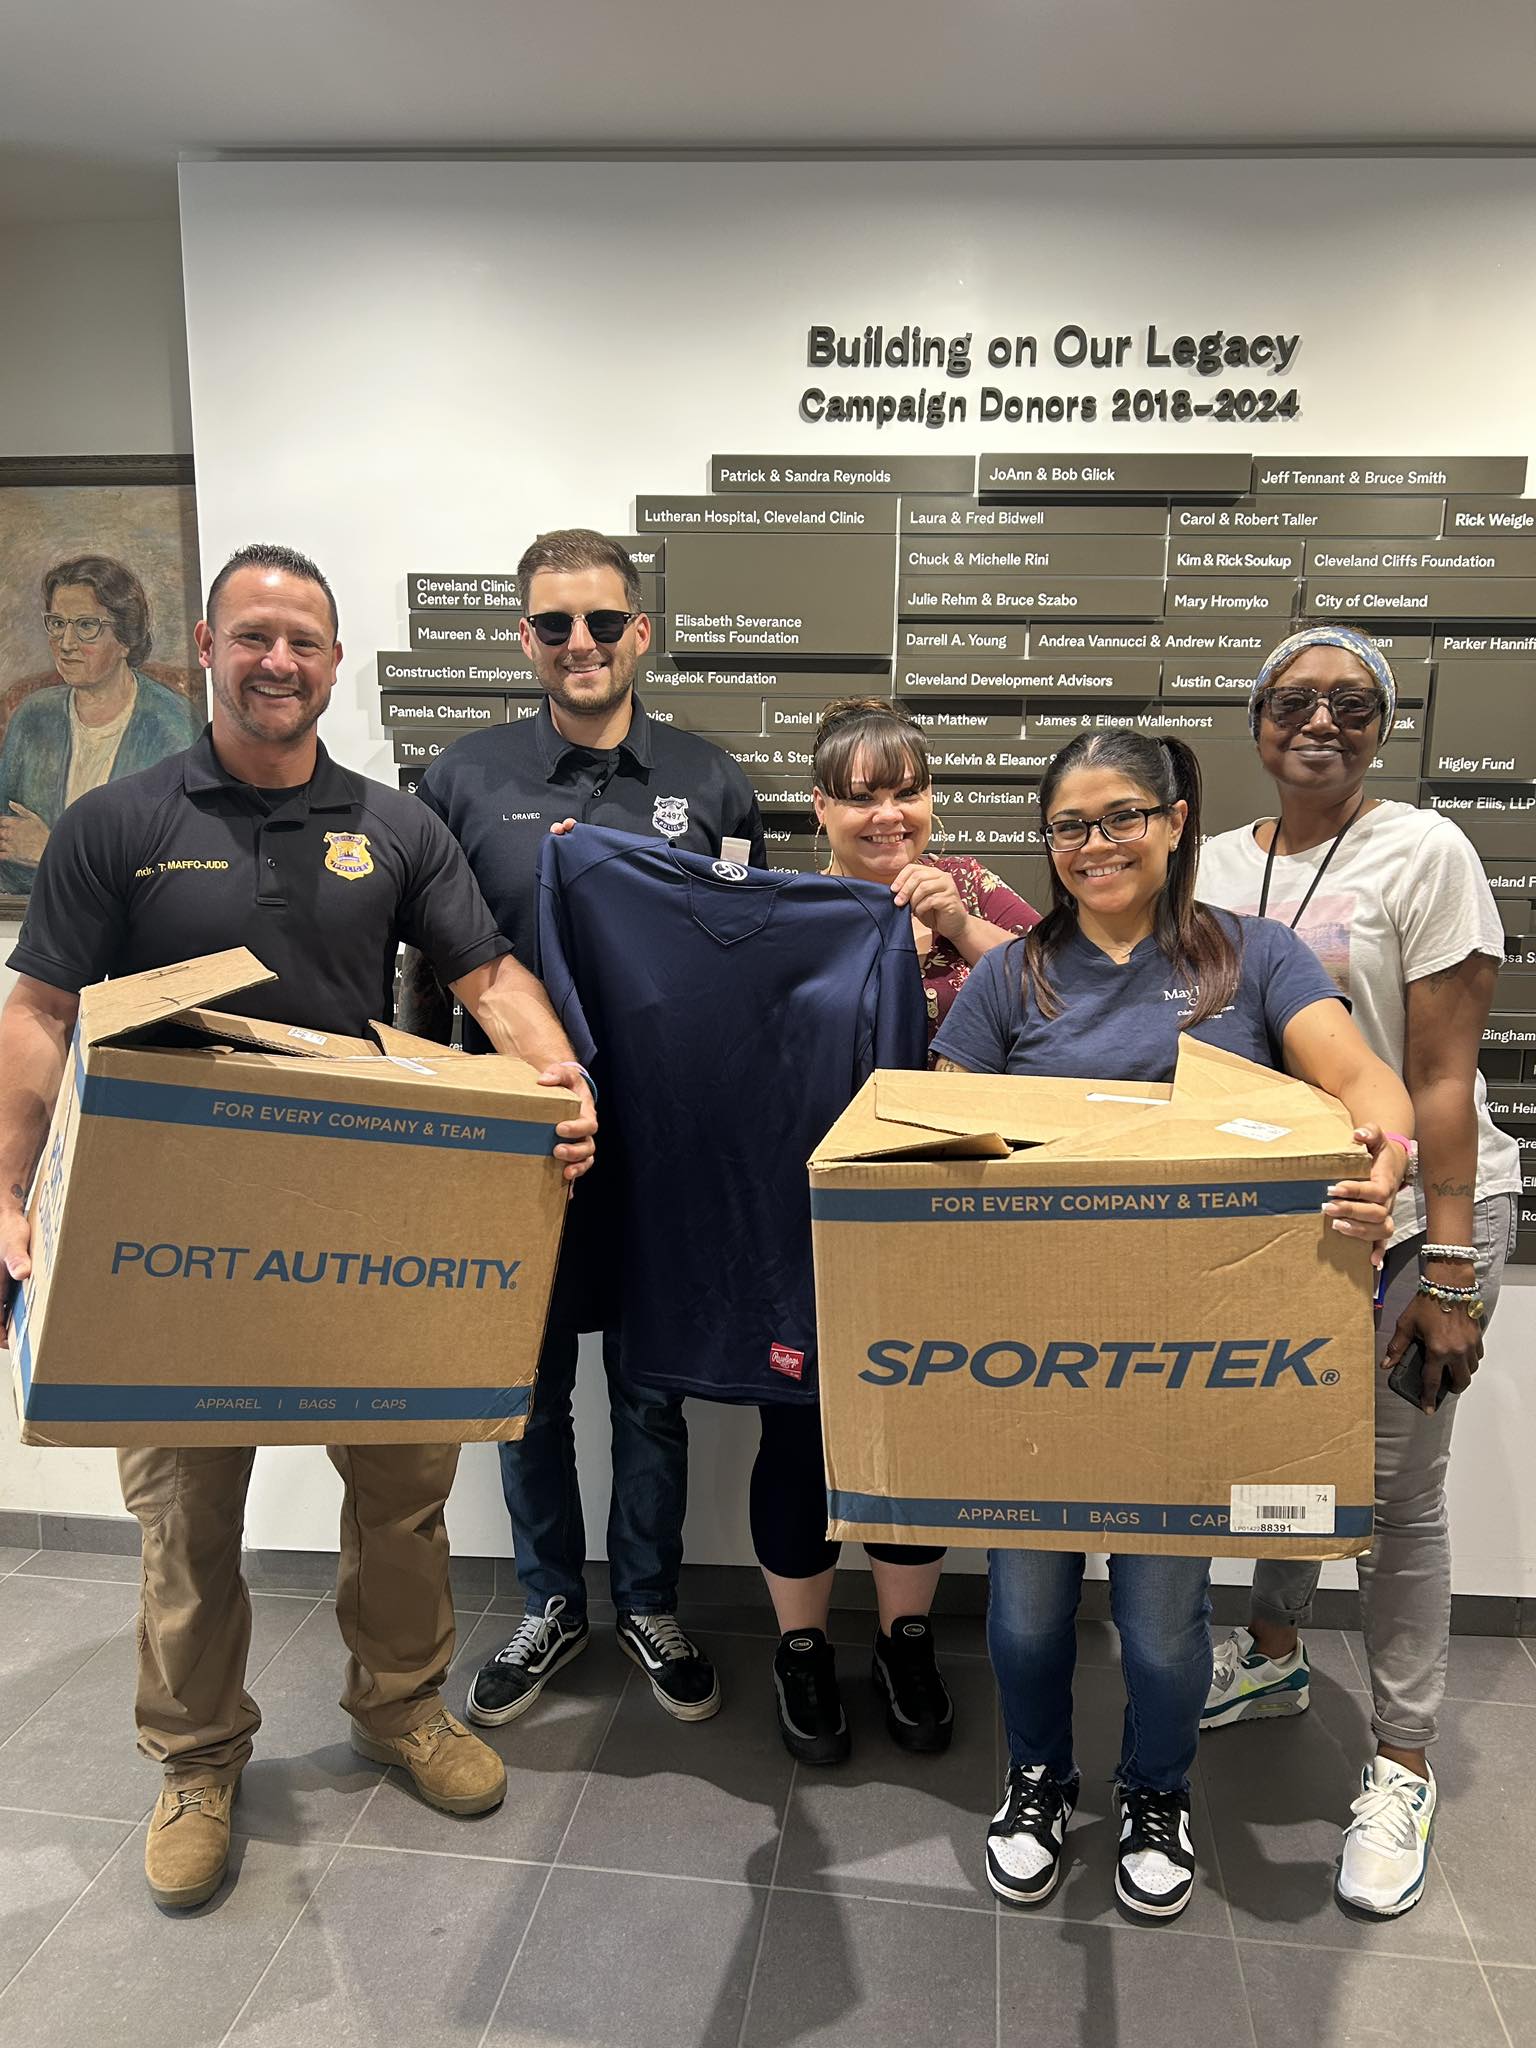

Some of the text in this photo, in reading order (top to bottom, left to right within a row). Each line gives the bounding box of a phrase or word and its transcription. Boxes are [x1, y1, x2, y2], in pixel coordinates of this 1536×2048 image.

[808, 324, 1300, 377] Building on Our Legacy
[799, 387, 966, 428] Campaign
[980, 387, 1097, 422] Donors
[720, 469, 766, 483] Patrick
[784, 469, 831, 483] Sandra
[833, 469, 891, 486] Reynolds
[989, 467, 1033, 481] JoAnn
[1051, 467, 1078, 481] Bob
[1081, 467, 1115, 481] Glick
[1261, 470, 1290, 484] Jeff
[1291, 471, 1346, 484] Tennant
[1364, 471, 1404, 485] Bruce
[1407, 470, 1447, 485] Smith
[645, 509, 865, 526] Lutheran Hospital, Cleveland Clinic
[910, 511, 947, 525] Laura
[965, 511, 995, 525] Fred
[998, 511, 1044, 525] Bidwell
[1180, 512, 1216, 526] Carol
[1234, 512, 1280, 526] Robert
[1281, 512, 1319, 526] Taller
[1455, 513, 1535, 530] Rick Weigle
[908, 552, 950, 566] Chuck
[968, 552, 1022, 566] Michelle
[1024, 552, 1049, 566] Rini
[1176, 553, 1202, 566] Kim
[1215, 553, 1244, 567] Rick
[1244, 553, 1292, 570] Soukup
[1314, 553, 1495, 568] Cleveland Cliffs Foundation
[416, 578, 516, 593] Cleveland Clinic
[417, 592, 460, 606] Center
[462, 592, 482, 606] for
[907, 592, 938, 606] Julie
[941, 592, 978, 606] Rehm
[996, 592, 1035, 607] Bruce
[1037, 592, 1078, 607] Szabo
[1174, 594, 1269, 611] Mary Hromyko
[1315, 593, 1429, 610] City of Cleveland
[675, 614, 802, 628] Elisabeth Severance
[417, 627, 472, 641] Maureen
[675, 630, 799, 644] Prentiss Foundation
[1038, 634, 1085, 648] Andrea
[1088, 634, 1147, 648] Vannucci
[1164, 634, 1216, 648] Andrew
[1218, 635, 1262, 648] Krantz
[906, 633, 1007, 650] Darrell A. Young
[1443, 637, 1488, 650] Parker
[385, 664, 533, 682] Construction Employers
[645, 670, 777, 686] Swagelok Foundation
[905, 672, 1113, 689] Cleveland Development Advisors
[1171, 674, 1212, 688] Justin
[389, 704, 491, 719] Pamela Charlton
[774, 711, 813, 725] Daniel
[910, 713, 988, 726] nita Mathew
[1035, 714, 1077, 727] James
[1095, 714, 1134, 727] Eileen
[1137, 714, 1213, 728] Wallenhorst
[401, 743, 426, 756] The
[944, 752, 983, 766] Kelvin
[999, 753, 1048, 766] Eleanor
[1438, 756, 1515, 773] Higley Fund
[967, 791, 1025, 804] Christian
[1430, 796, 1474, 810] Tucker
[1509, 797, 1536, 810] LLP
[511, 812, 541, 821] ORAVEC
[958, 830, 973, 842] H.
[989, 830, 1025, 843] David
[1027, 830, 1040, 843] S.
[167, 860, 229, 871] MAFFO-JUDD
[212, 1101, 254, 1119] FOR
[260, 1105, 323, 1126] EVERY
[328, 1112, 419, 1135] COMPANY
[439, 1123, 487, 1141] TEAM
[930, 1195, 978, 1213] FOR
[982, 1195, 1056, 1213] EVERY
[1059, 1193, 1172, 1212] COMPANY
[1196, 1191, 1259, 1209] TEAM
[111, 1241, 250, 1281] PORT
[194, 1398, 408, 1411] APPAREL BAGS CAPS
[1315, 1493, 1328, 1503] 74
[956, 1507, 1229, 1527] APPAREL BAGS CAP
